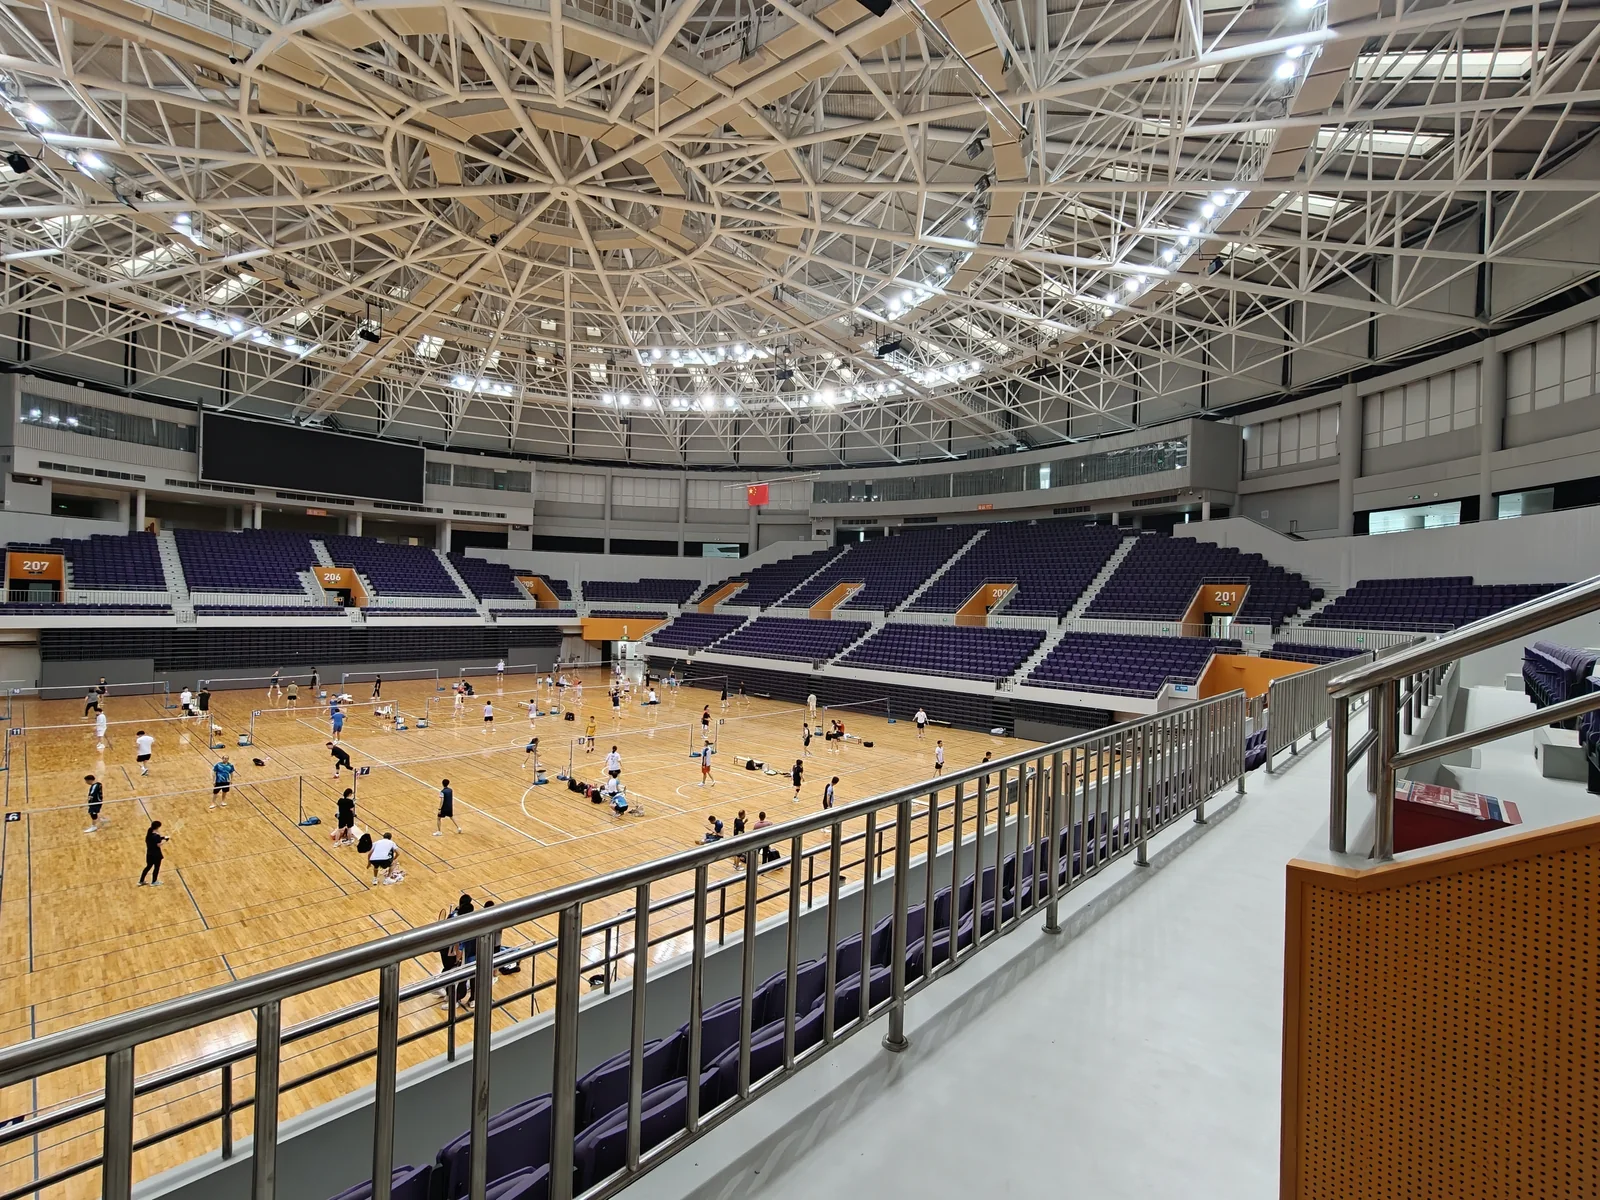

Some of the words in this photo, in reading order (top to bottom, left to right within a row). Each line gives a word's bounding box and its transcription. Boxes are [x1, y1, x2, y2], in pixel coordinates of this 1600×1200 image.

[23, 561, 49, 571] 207
[324, 573, 341, 581] 206
[1215, 592, 1236, 602] 201
[623, 625, 628, 635] 1
[8, 813, 18, 821] 6
